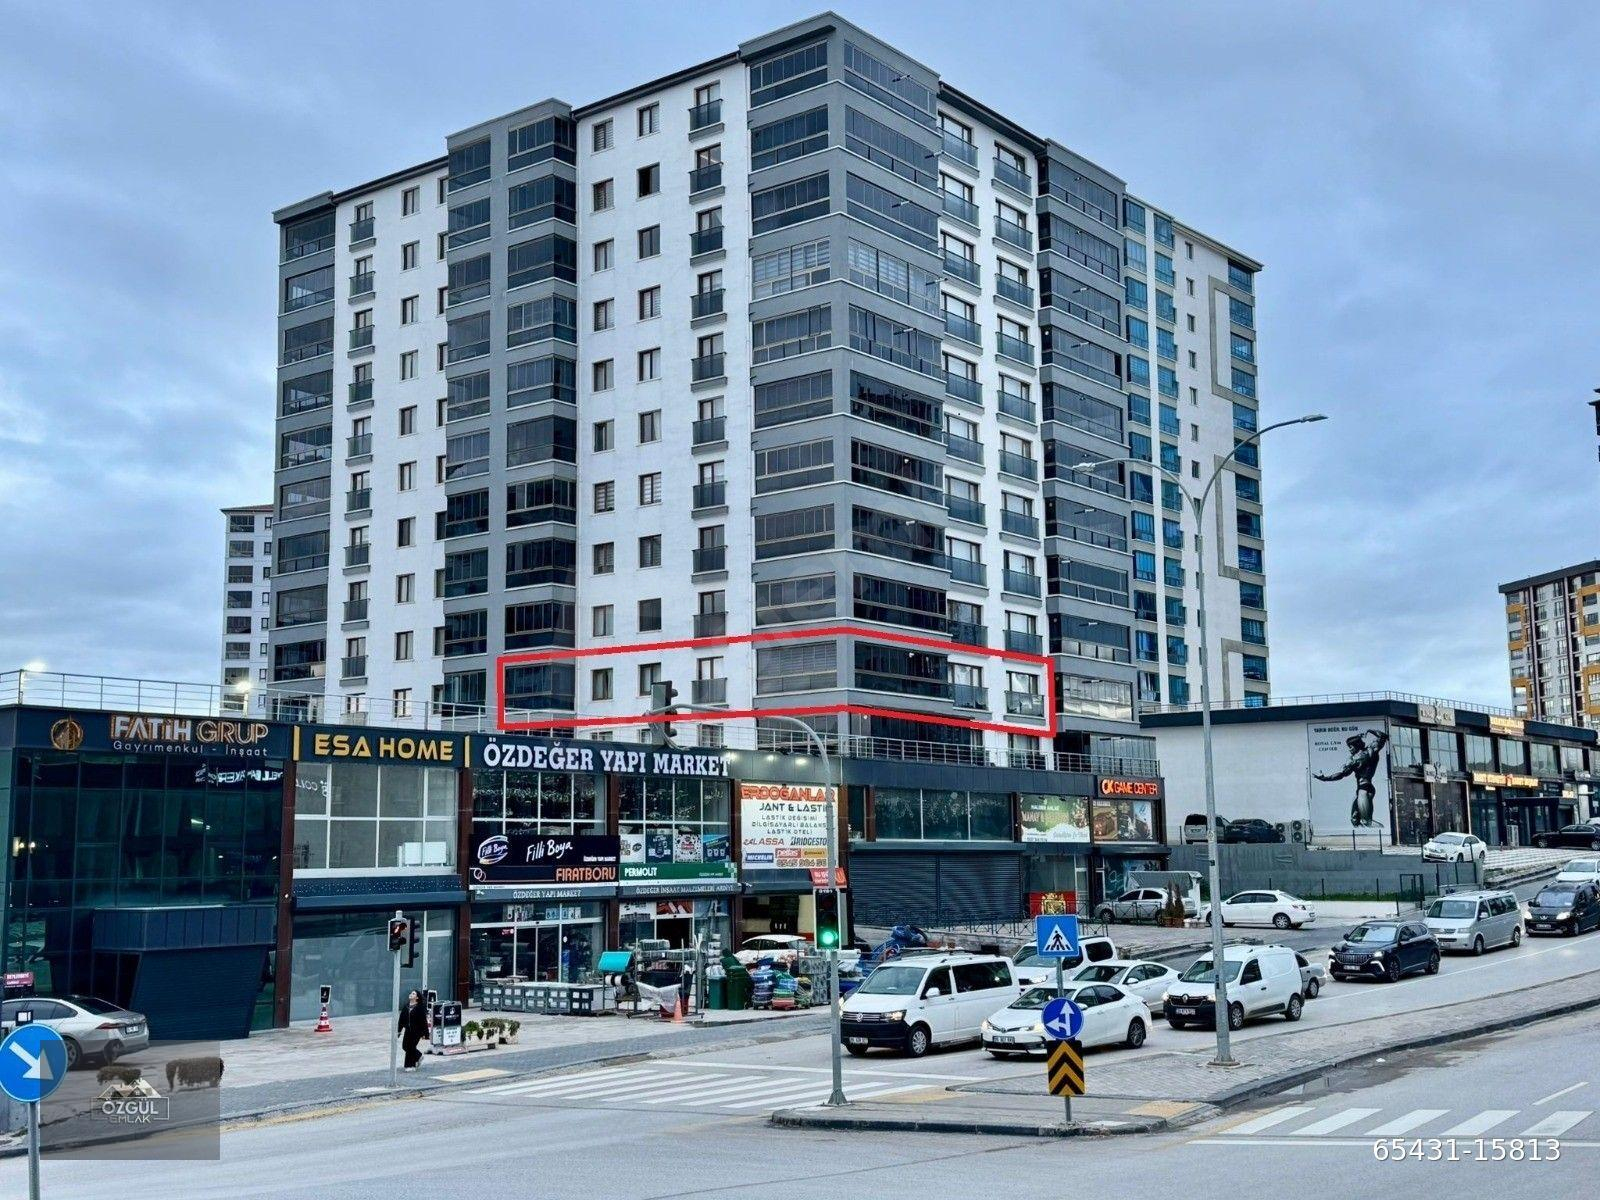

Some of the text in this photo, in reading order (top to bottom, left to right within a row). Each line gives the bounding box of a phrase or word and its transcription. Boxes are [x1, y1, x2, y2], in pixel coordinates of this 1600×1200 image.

[197, 720, 269, 745] GRUP
[314, 733, 454, 761] ESA HOME
[483, 737, 730, 777] ÖZDEĞER YAPI MARKET
[1114, 781, 1133, 794] GAME
[1134, 782, 1158, 795] CENTER
[759, 803, 785, 811] JANT
[788, 803, 794, 812] &
[790, 836, 833, 846] BRIDGESTO
[526, 839, 573, 862] Filli Boya
[556, 867, 616, 881] FIRATBORU
